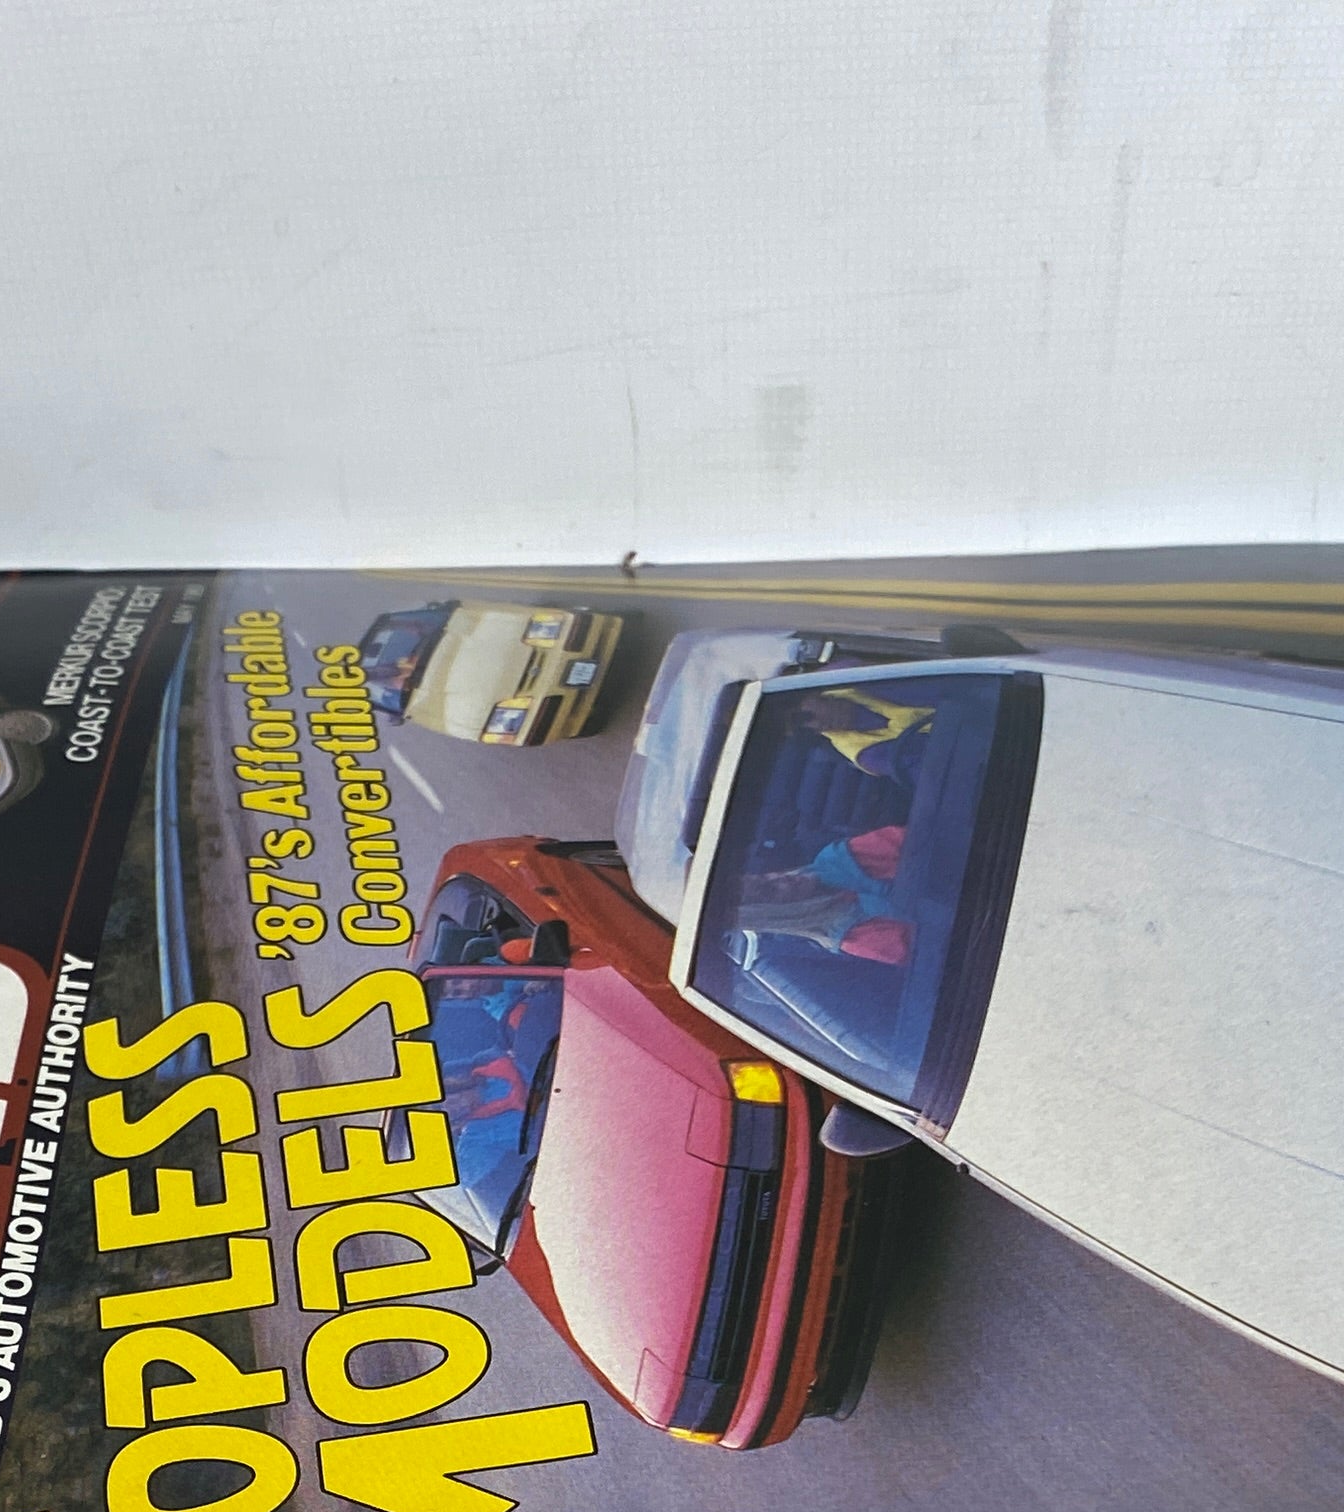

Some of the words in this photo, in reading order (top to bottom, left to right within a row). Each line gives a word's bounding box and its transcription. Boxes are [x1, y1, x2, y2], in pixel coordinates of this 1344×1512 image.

[223, 610, 310, 819] Affordable
[305, 645, 415, 947] Convertibles
[247, 829, 326, 961] '87's
[29, 952, 95, 1134] AUTHORITY
